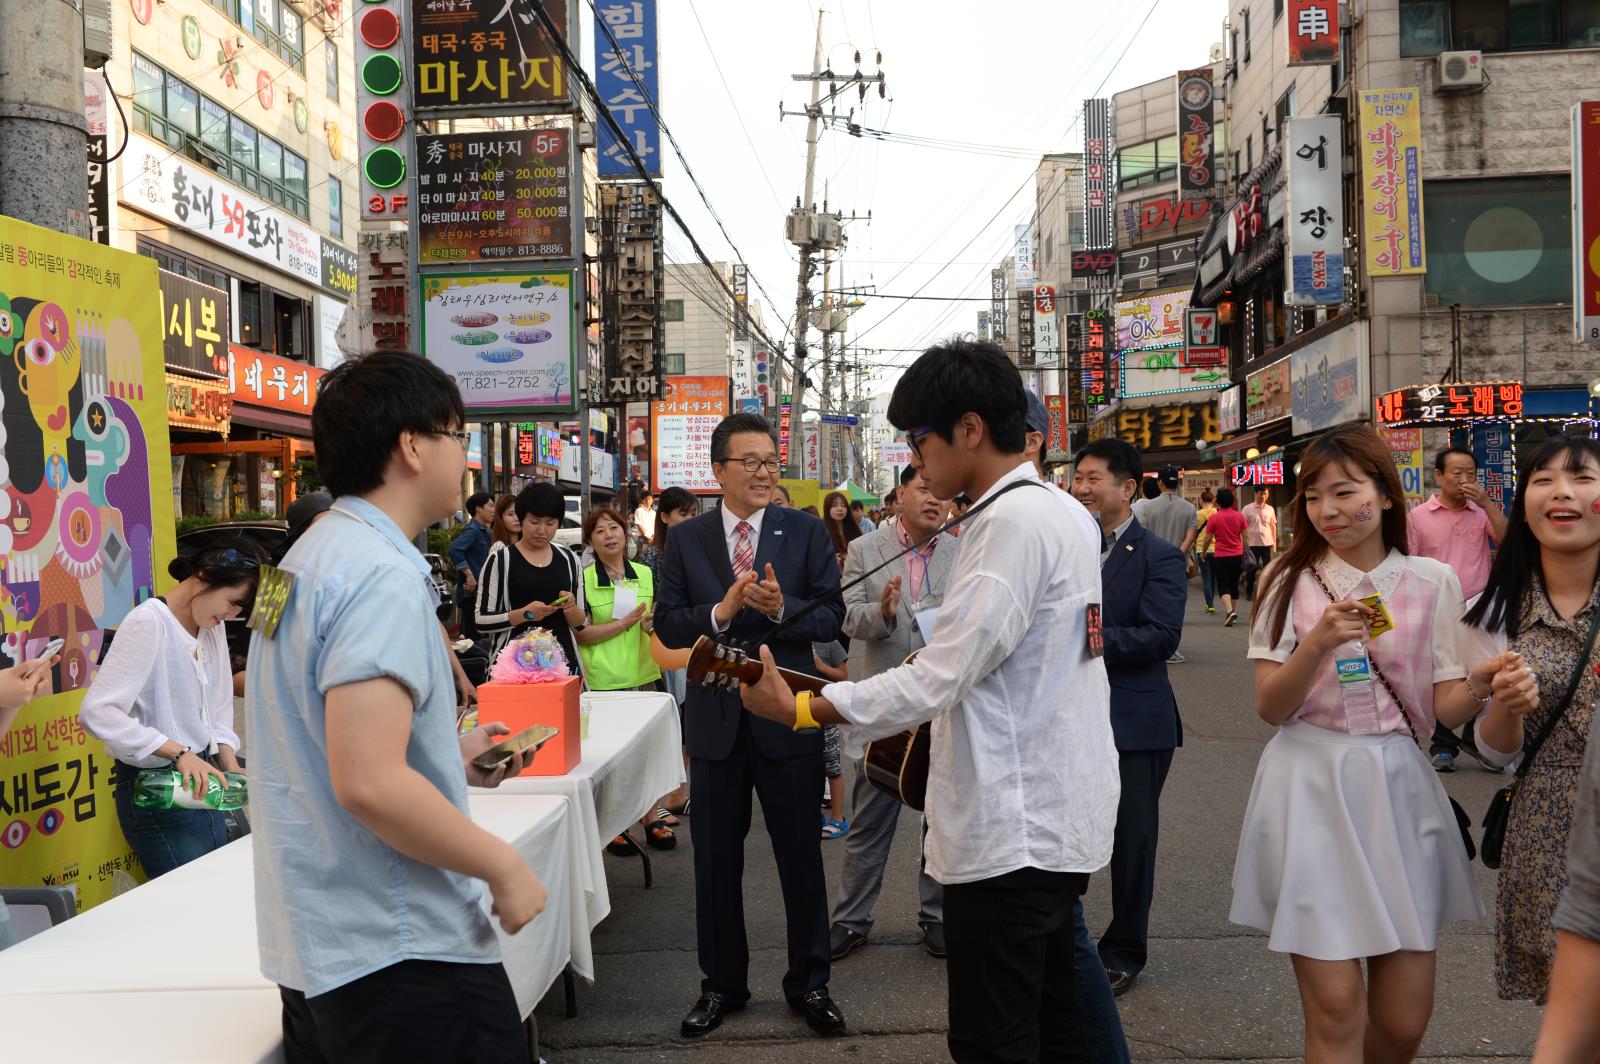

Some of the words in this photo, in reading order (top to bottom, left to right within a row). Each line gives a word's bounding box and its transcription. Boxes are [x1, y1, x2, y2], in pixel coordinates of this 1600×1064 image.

[1298, 6, 1329, 40] 串
[418, 55, 563, 102] 마사지
[468, 140, 522, 158] 마사지
[536, 135, 560, 153] 5F
[481, 170, 505, 183] 40분
[1088, 138, 1105, 207] 영화관
[482, 190, 506, 202] 40분
[1296, 135, 1334, 240] 어장
[368, 195, 409, 213] 3F
[1141, 199, 1210, 230] DVD
[421, 210, 480, 224] 아로마마사지
[482, 209, 506, 221] 60분
[518, 243, 564, 256] 813-8886
[17, 246, 65, 275] 동아리들의
[67, 259, 102, 285] 감각적인
[104, 270, 121, 290] 축제
[1074, 253, 1118, 270] DVD
[1312, 250, 1327, 289] NEWS
[734, 265, 746, 296] BAR
[368, 251, 408, 350] 노래방
[1038, 286, 1054, 312] 오감
[1087, 310, 1106, 320] OK
[1130, 317, 1157, 341] OK
[1040, 320, 1053, 361] 마사지
[1145, 352, 1177, 372] OK
[463, 376, 540, 390] T.821-2752
[610, 376, 659, 395] 지하
[1088, 395, 1106, 403] 2F
[1450, 385, 1523, 416] 노래방
[1420, 405, 1445, 419] 2F
[0, 725, 38, 759] 제1회
